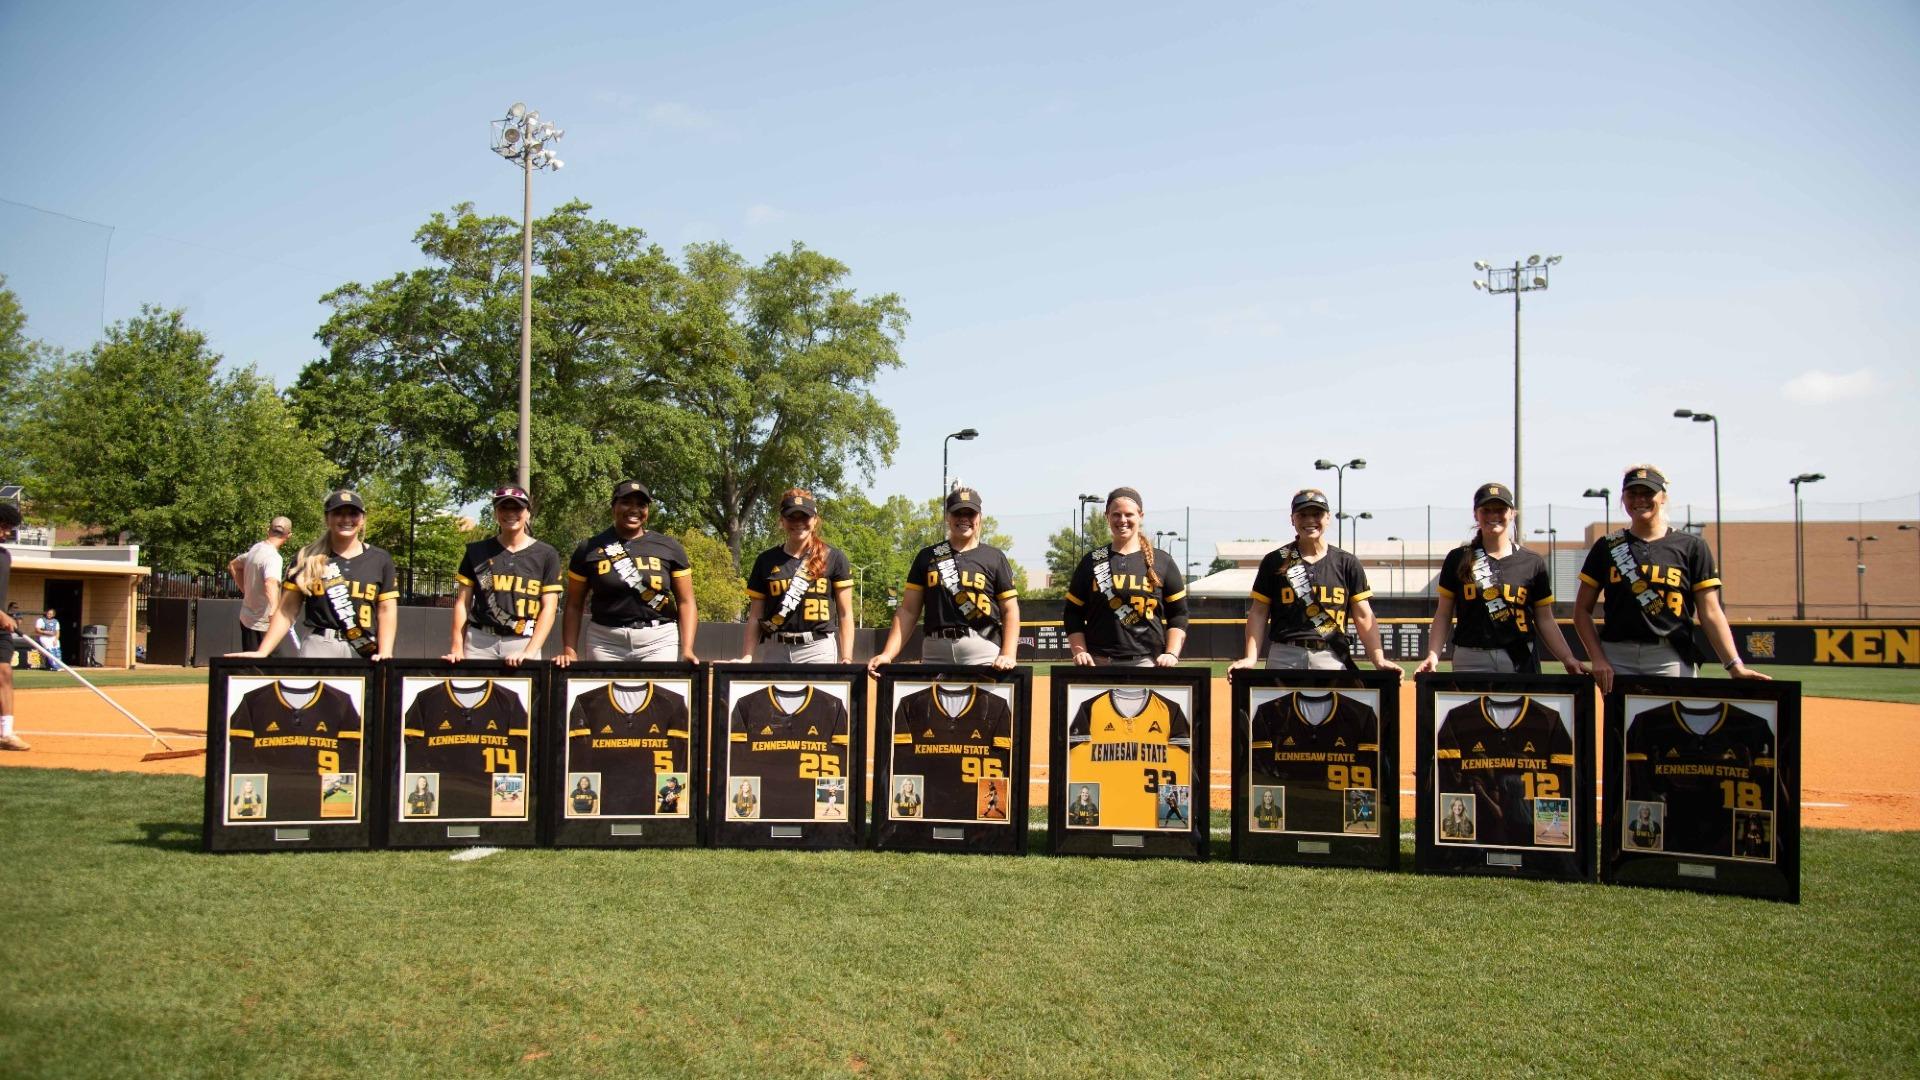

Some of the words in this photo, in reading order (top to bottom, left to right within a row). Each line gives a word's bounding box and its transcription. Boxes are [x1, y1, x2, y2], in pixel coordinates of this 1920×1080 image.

[598, 557, 662, 575] OLS
[1610, 565, 1682, 587] OLS
[312, 579, 377, 601] OLS
[492, 574, 542, 594] WLS
[927, 570, 986, 590] OLS
[1092, 574, 1154, 593] WLS
[1281, 585, 1345, 604] OLS
[1463, 583, 1528, 606] OLS
[1657, 589, 1684, 617] 8
[359, 604, 372, 628] 9
[515, 598, 541, 618] 14
[803, 598, 830, 621] 25
[1510, 607, 1528, 633] 2
[254, 736, 309, 748] KENNESAW
[309, 736, 339, 749] STATE
[428, 734, 480, 747] KENNESAW
[480, 735, 509, 747] STATE
[592, 738, 641, 749] KENNESAW
[641, 738, 669, 748] STATE
[751, 740, 800, 752] KENNESAW
[800, 741, 828, 752] STATE
[915, 744, 962, 755] KENNESAW
[963, 744, 990, 755] STATE
[318, 749, 340, 776] 9
[482, 747, 518, 774] 14
[652, 750, 674, 774] 5
[1091, 742, 1139, 762] KENNESAW
[1140, 743, 1168, 763] STATE
[1274, 752, 1325, 762] KENNESAW
[1326, 752, 1356, 763] STATE
[799, 752, 841, 779] 25
[961, 756, 1003, 783] 96
[1461, 757, 1516, 770] KENNESAW
[1517, 758, 1548, 770] STATE
[1655, 764, 1714, 777] KENNESAW
[1714, 765, 1750, 779] STATE
[1327, 764, 1372, 791] 99
[1520, 772, 1561, 801] 12
[1719, 780, 1763, 810] 18
